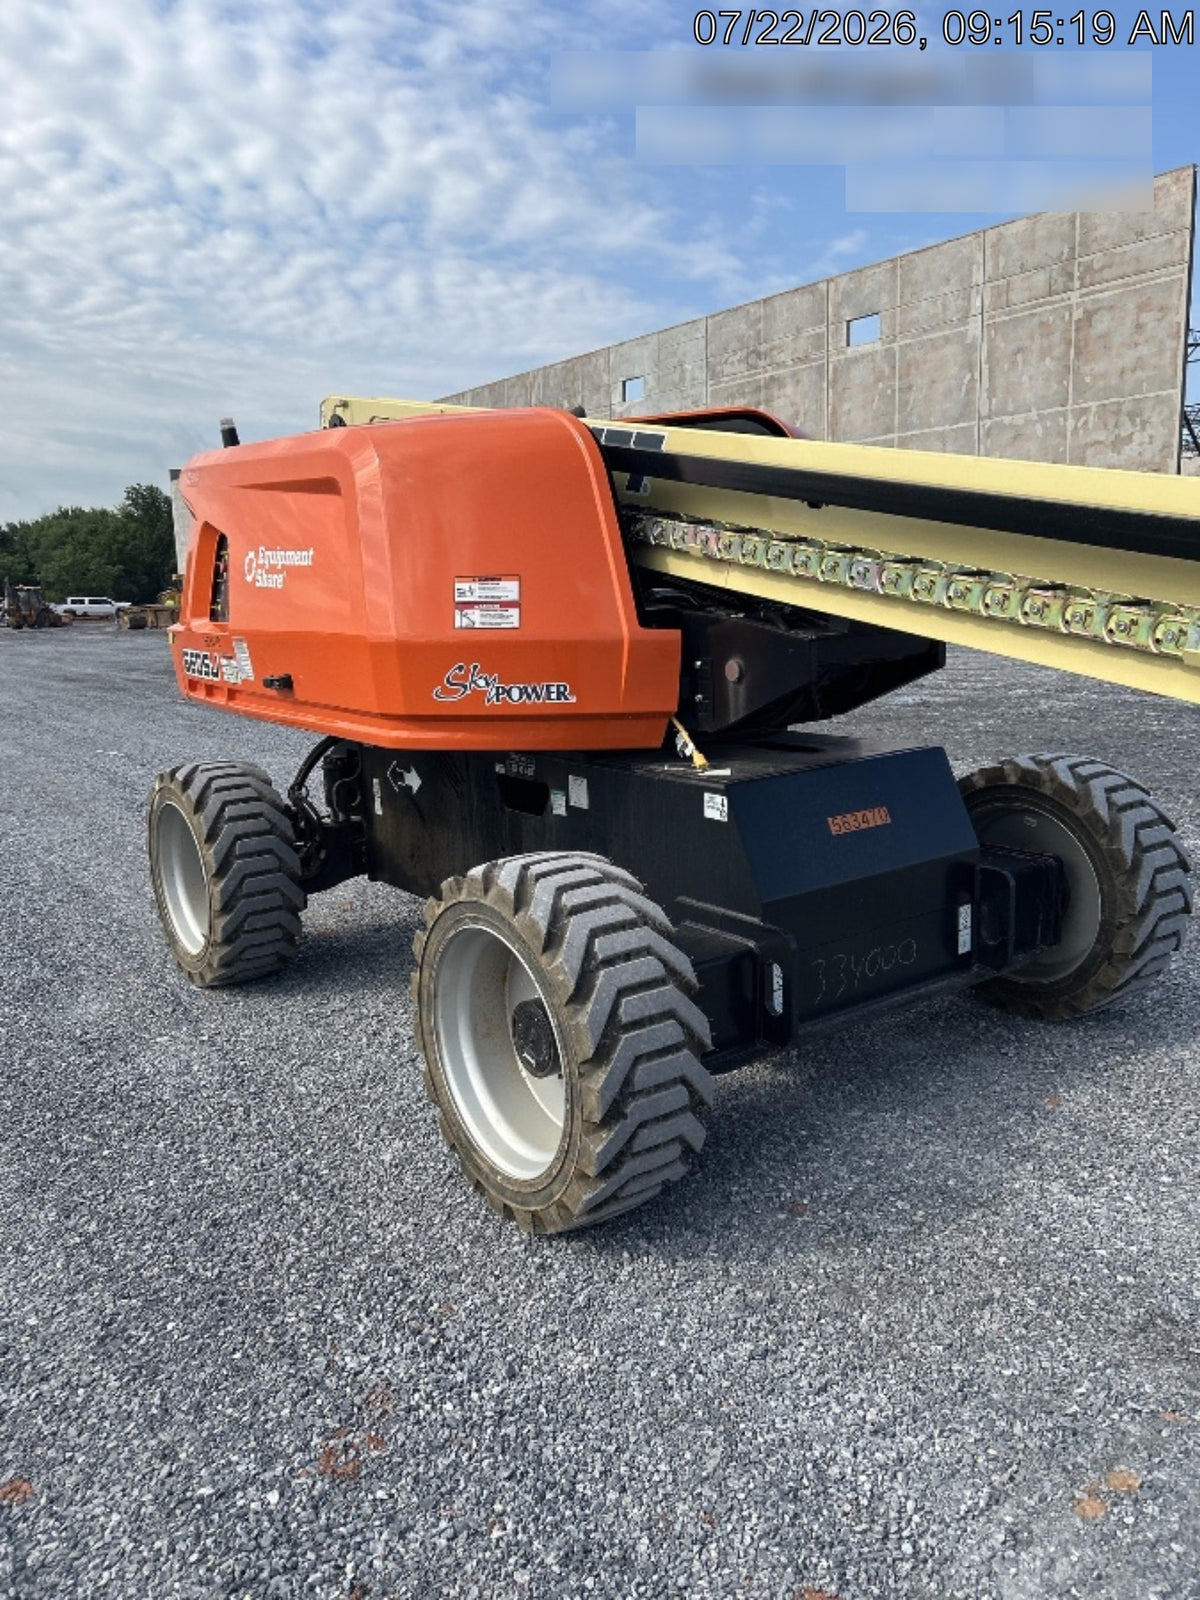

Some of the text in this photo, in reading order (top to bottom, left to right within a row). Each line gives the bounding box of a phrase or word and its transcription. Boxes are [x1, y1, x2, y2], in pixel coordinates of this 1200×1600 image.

[258, 546, 314, 569] Equipment
[255, 568, 284, 589] Share
[433, 662, 573, 706] Sky POWER
